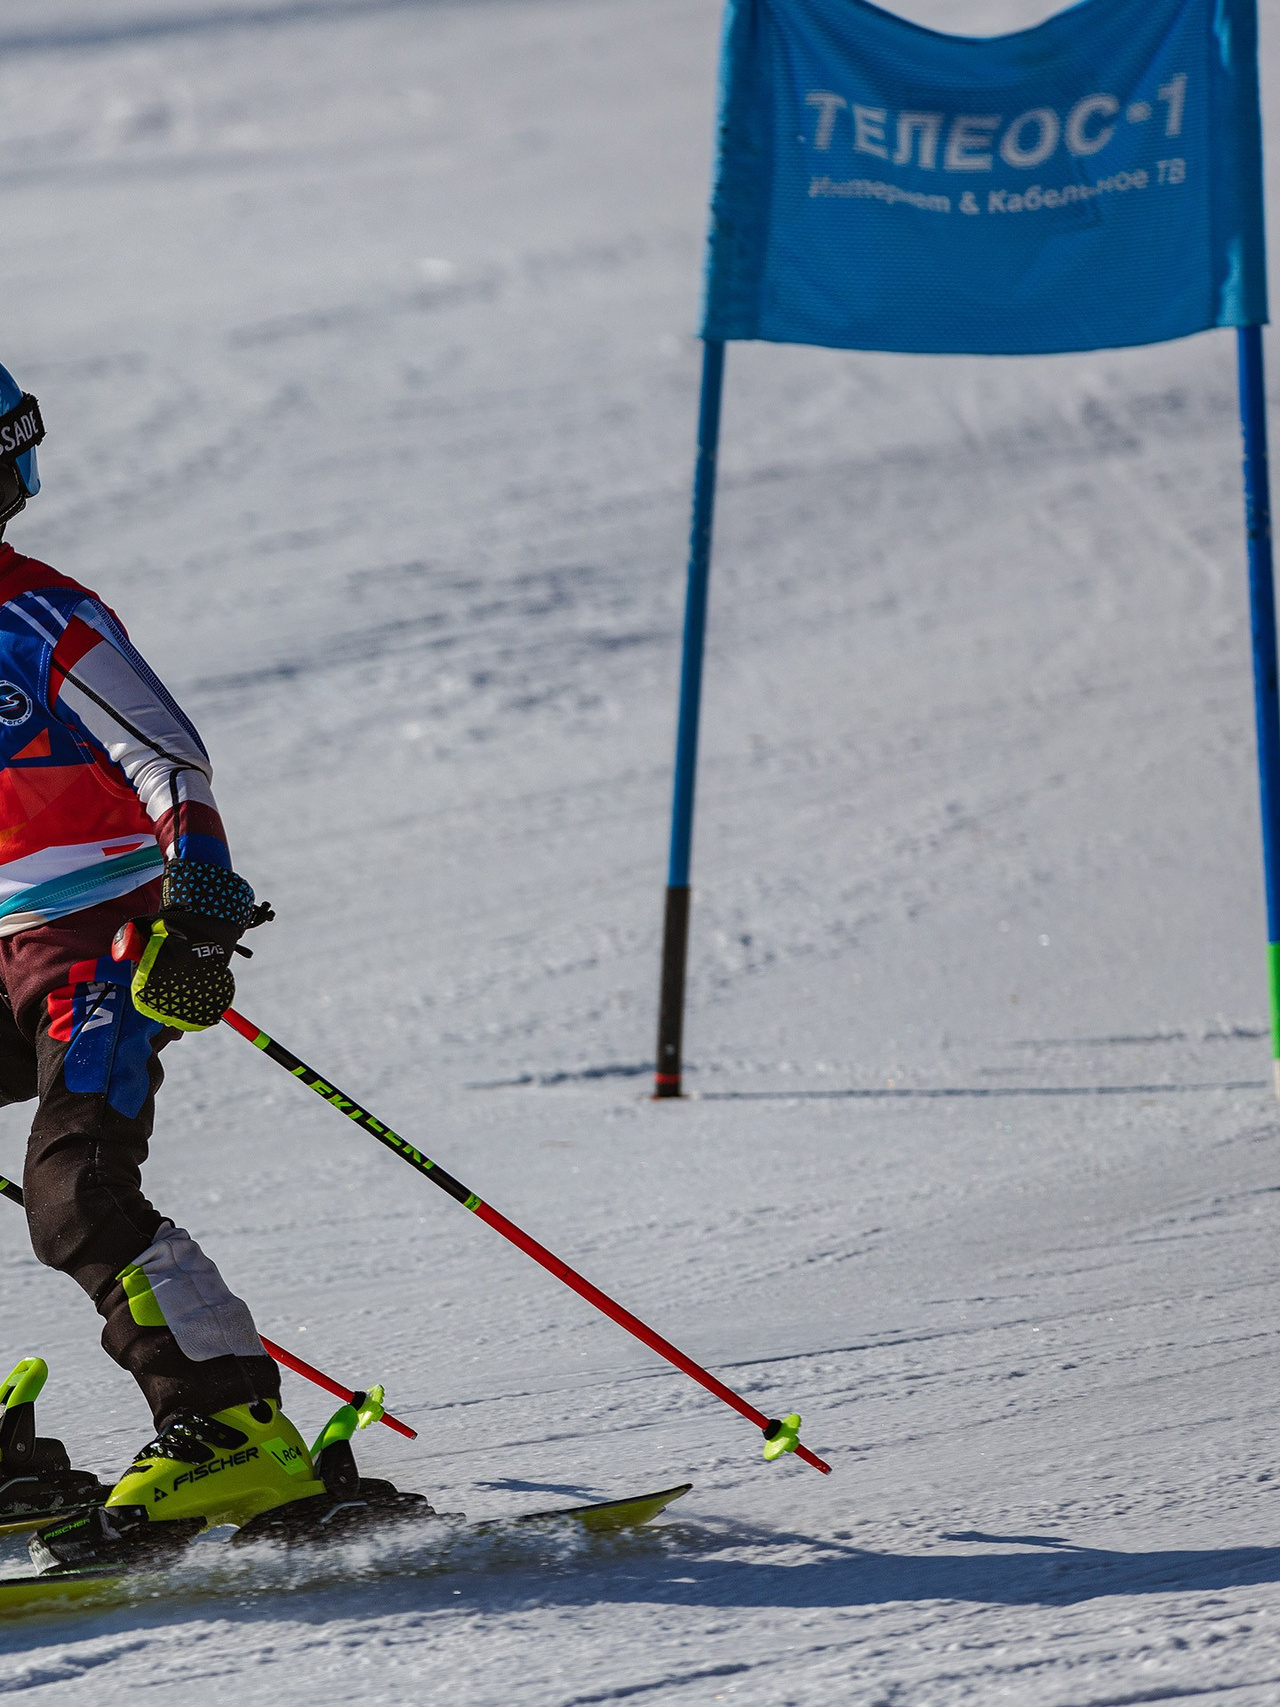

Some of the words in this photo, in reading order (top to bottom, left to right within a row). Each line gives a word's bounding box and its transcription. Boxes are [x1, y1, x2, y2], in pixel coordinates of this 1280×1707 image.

[959, 191, 980, 215] &
[1156, 158, 1186, 184] ТВ
[173, 1447, 259, 1492] FISCHER
[43, 1518, 90, 1540] FISCHER
